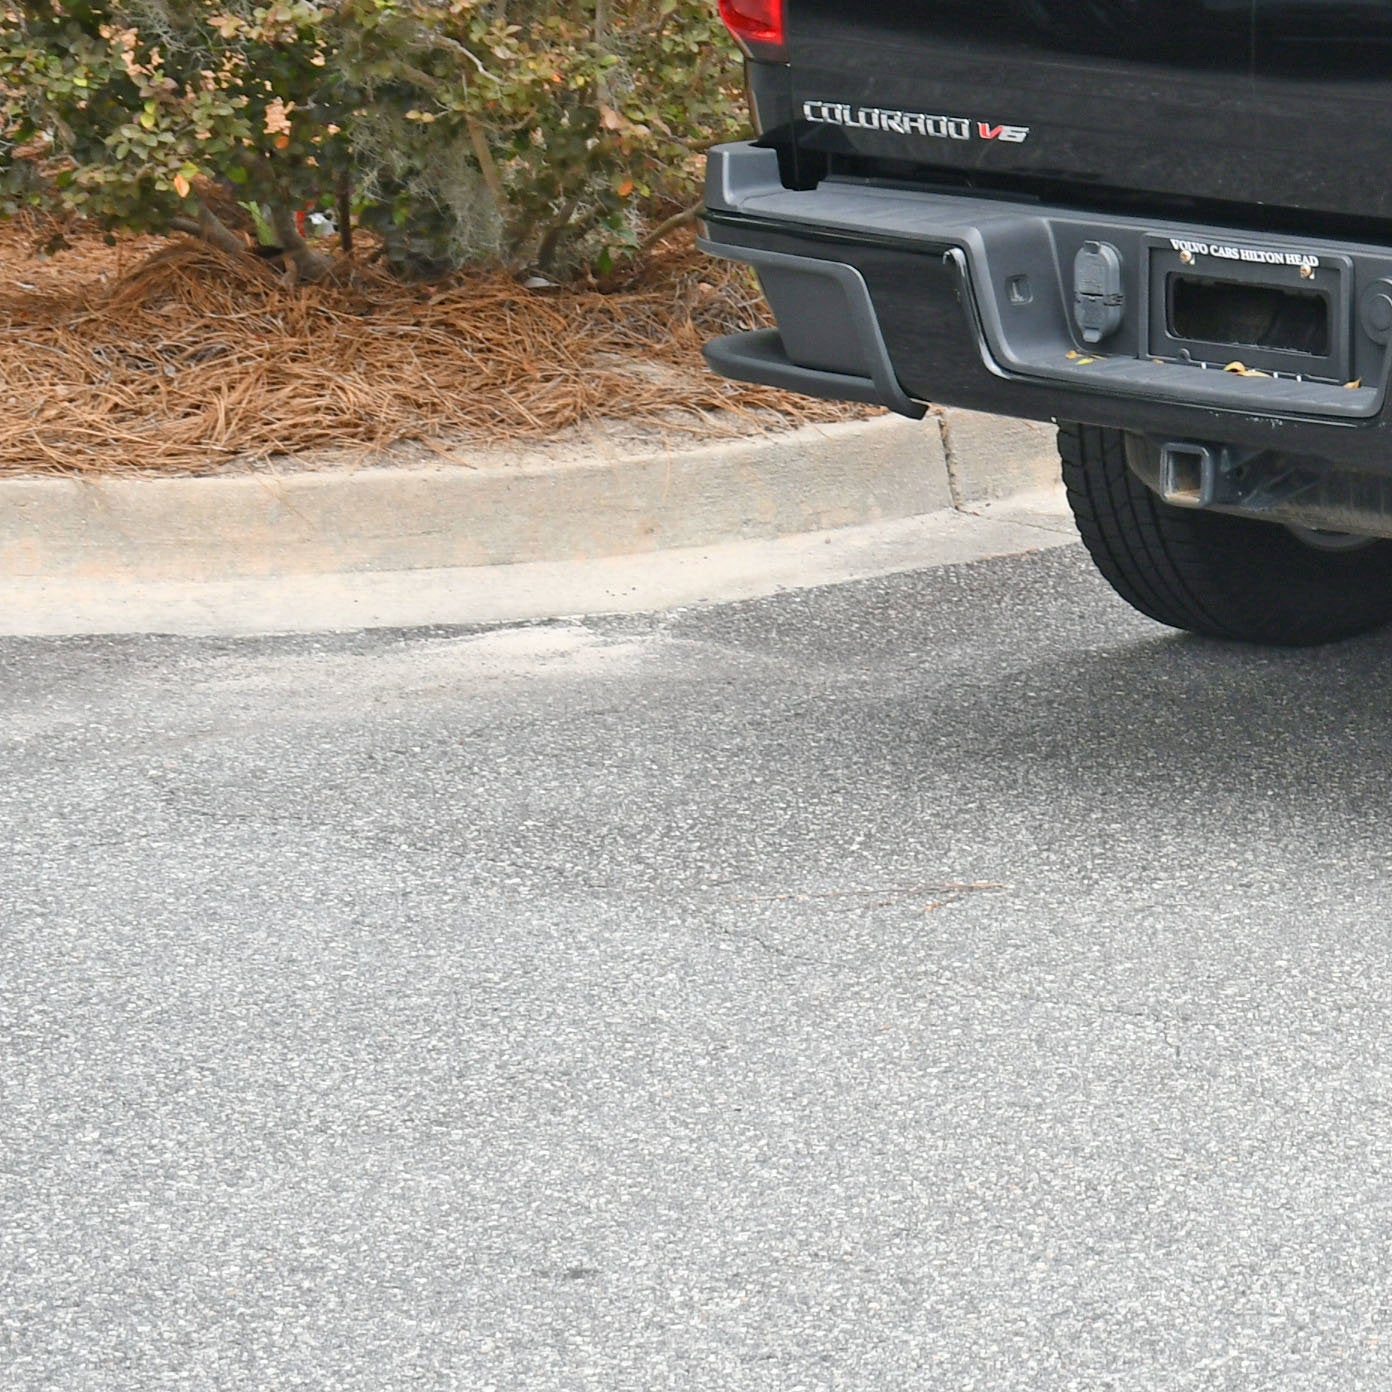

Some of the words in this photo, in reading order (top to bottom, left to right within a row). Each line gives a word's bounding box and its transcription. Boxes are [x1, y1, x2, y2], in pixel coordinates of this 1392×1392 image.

[803, 100, 971, 140] COLORADO
[976, 121, 1030, 143] V6
[1170, 239, 1208, 255] VOLVO
[1210, 245, 1240, 259] CARS
[1240, 249, 1285, 264] HILTON
[1286, 253, 1319, 267] HEAD
